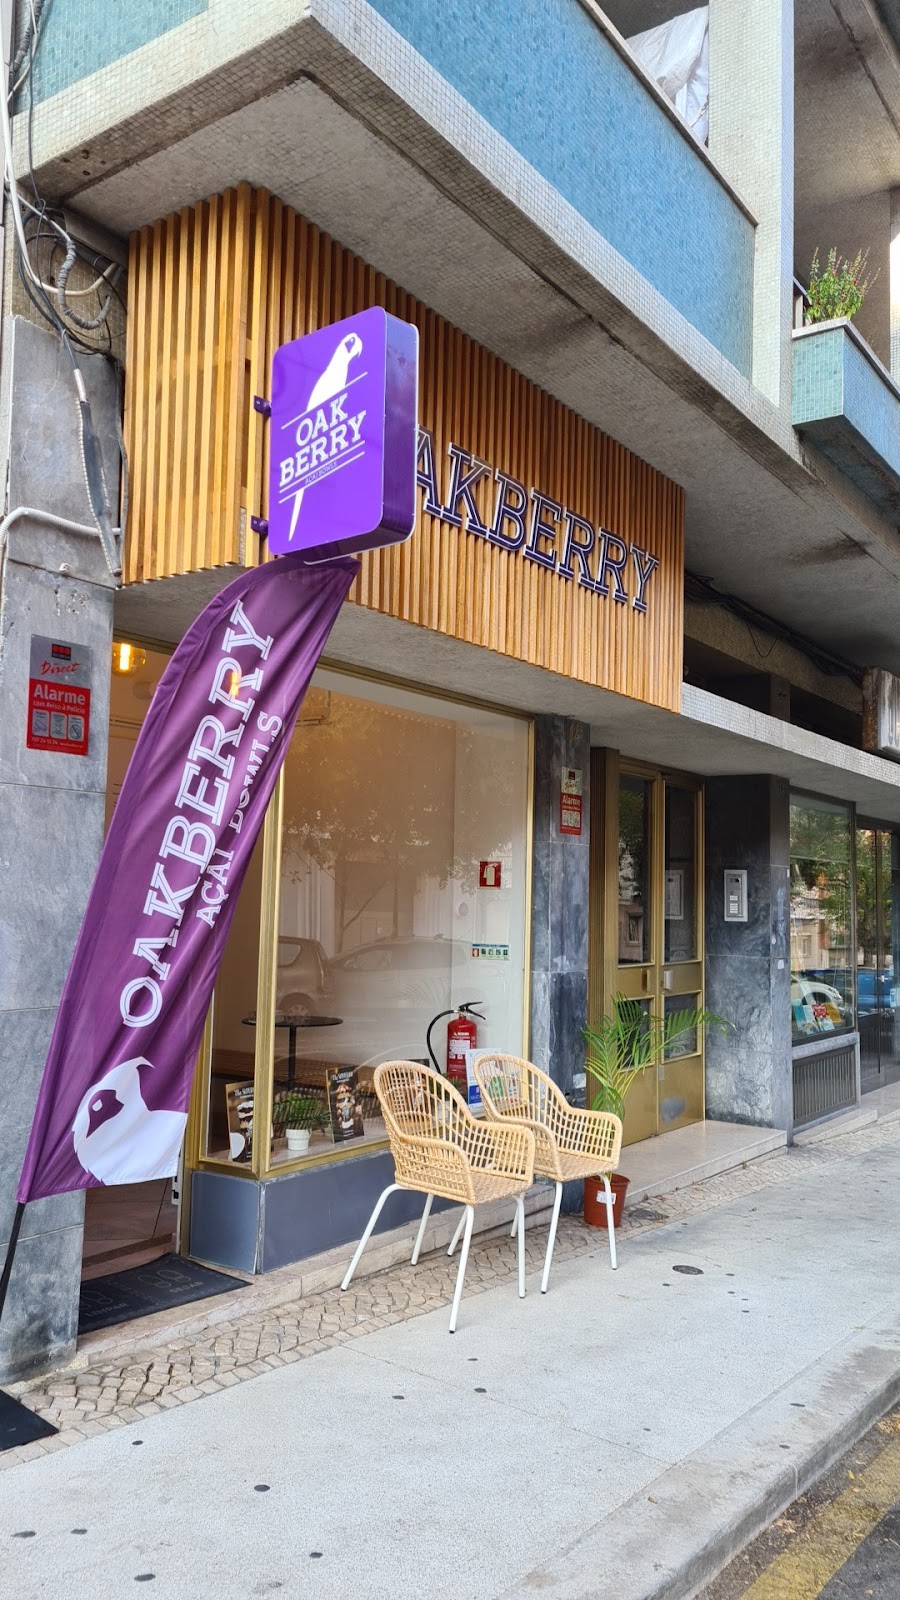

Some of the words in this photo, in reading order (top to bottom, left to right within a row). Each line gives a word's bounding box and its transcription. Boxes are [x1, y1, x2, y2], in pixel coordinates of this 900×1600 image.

[296, 393, 348, 447] OAK
[279, 409, 367, 488] BERRY
[40, 660, 80, 675] Direct
[33, 684, 86, 706] Alarme
[46, 702, 61, 710] Aviso
[562, 795, 581, 806] Alarme
[119, 599, 275, 1029] OAKBERRY
